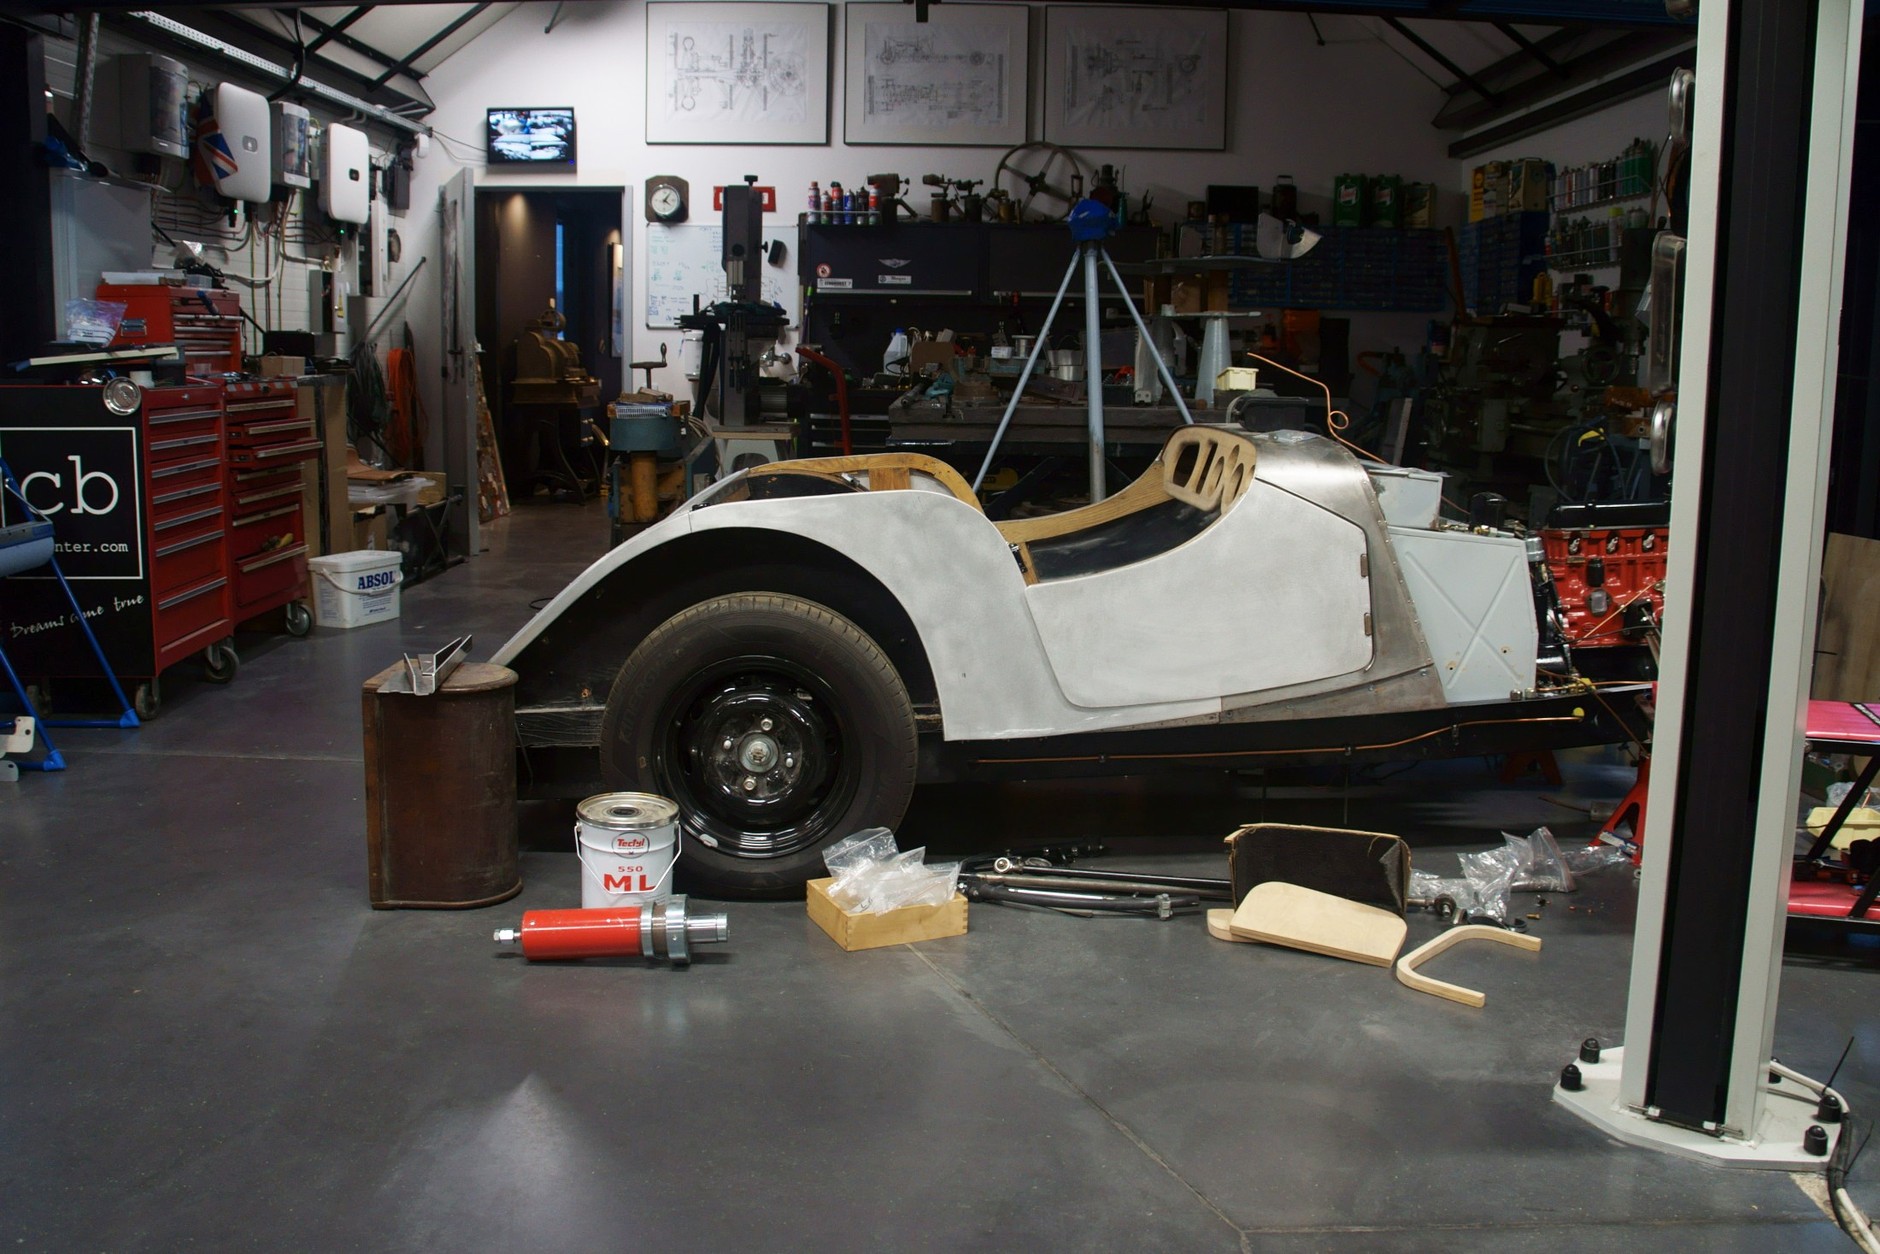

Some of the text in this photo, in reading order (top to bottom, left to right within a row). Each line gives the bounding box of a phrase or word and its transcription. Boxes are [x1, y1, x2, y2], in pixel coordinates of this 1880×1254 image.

[20, 454, 119, 515] cb
[55, 542, 129, 553] nter.com
[358, 571, 395, 590] ABSOL
[10, 615, 65, 639] Dreams
[113, 593, 145, 612] true
[617, 838, 645, 847] Tectyl
[604, 873, 656, 892] ML
